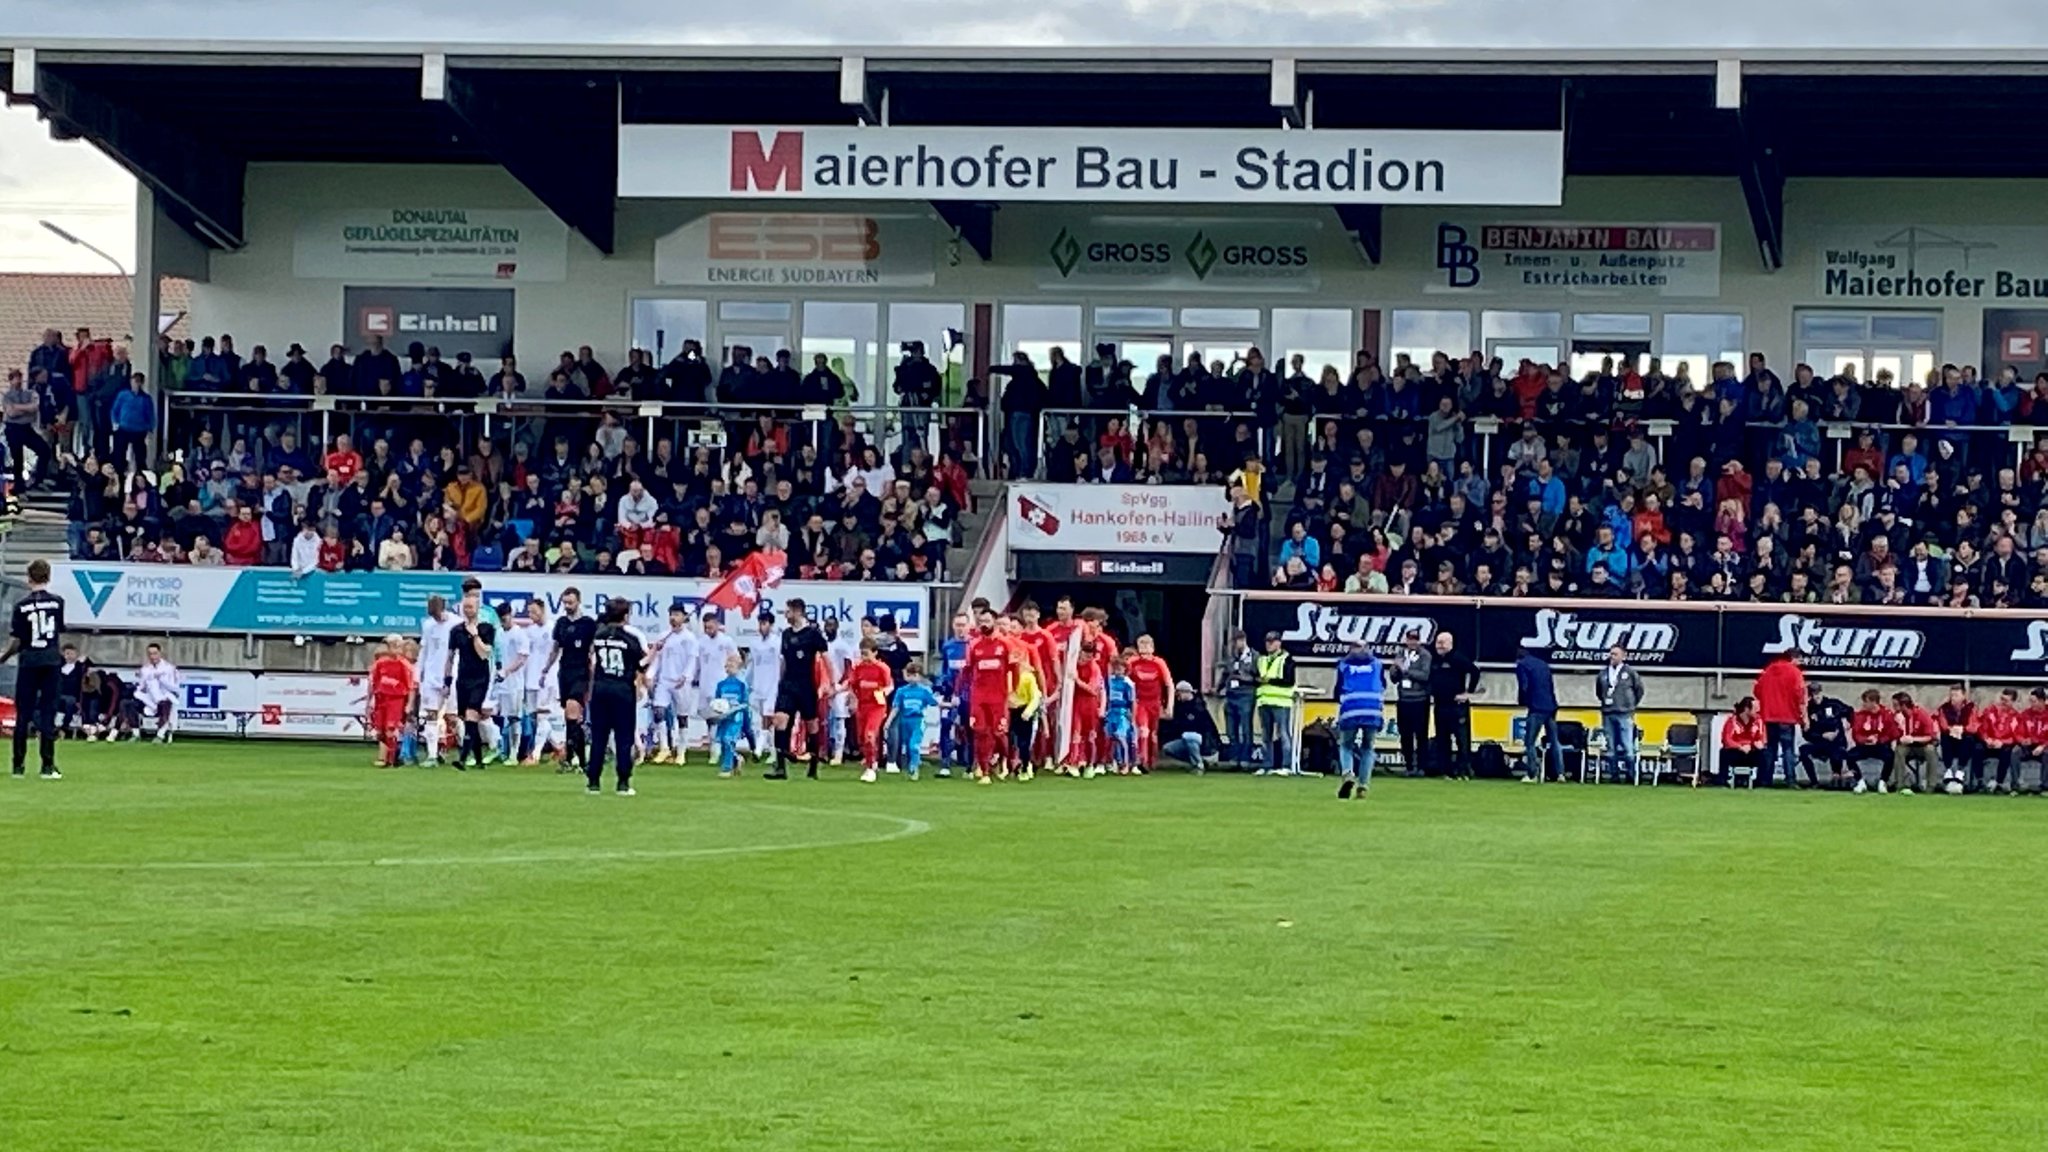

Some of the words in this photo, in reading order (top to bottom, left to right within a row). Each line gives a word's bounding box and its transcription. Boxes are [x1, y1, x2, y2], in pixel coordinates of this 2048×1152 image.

[730, 131, 1057, 191] Maierhofer
[1076, 146, 1178, 190] Bau
[1234, 147, 1444, 193] Stadion
[392, 209, 467, 224] DONAUTAL
[707, 215, 880, 261] ESB
[1486, 229, 1610, 249] BENJAMIN
[1087, 242, 1171, 263] GROSS
[1222, 245, 1308, 266] GROSS
[1825, 250, 1896, 269] Wolfgang
[707, 268, 780, 282] ENERGIE
[1523, 270, 1667, 286] Estricharbeiten
[1825, 269, 1985, 298] Maierhofer
[1995, 271, 2048, 298] Bau
[399, 314, 497, 333] Einhell
[127, 576, 182, 591] PHYSIO
[127, 593, 181, 608] KLINIK
[27, 610, 55, 648] 14
[1281, 602, 1436, 644] Sturm
[1520, 608, 1678, 651] Sturm
[1762, 614, 1925, 658] Sturm
